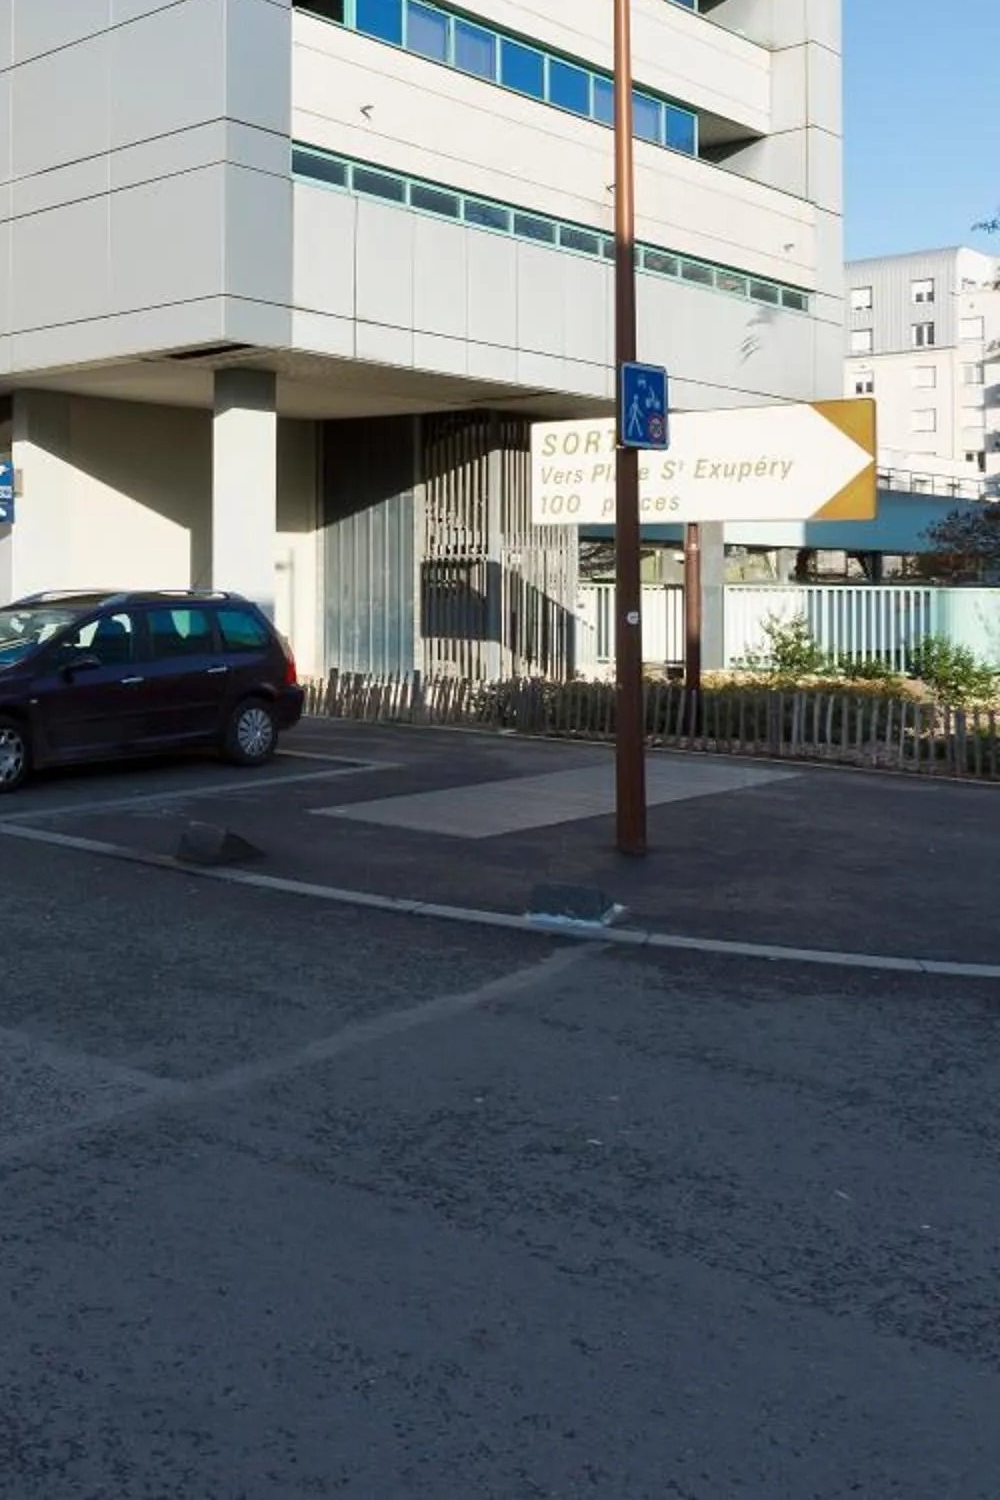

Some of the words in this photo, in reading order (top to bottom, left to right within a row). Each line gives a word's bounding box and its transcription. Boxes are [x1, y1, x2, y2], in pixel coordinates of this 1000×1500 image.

[541, 466, 583, 484] Vers
[591, 463, 650, 483] Ple
[693, 456, 794, 483] Exupéry
[541, 494, 581, 514] 100
[601, 497, 681, 516] pces
